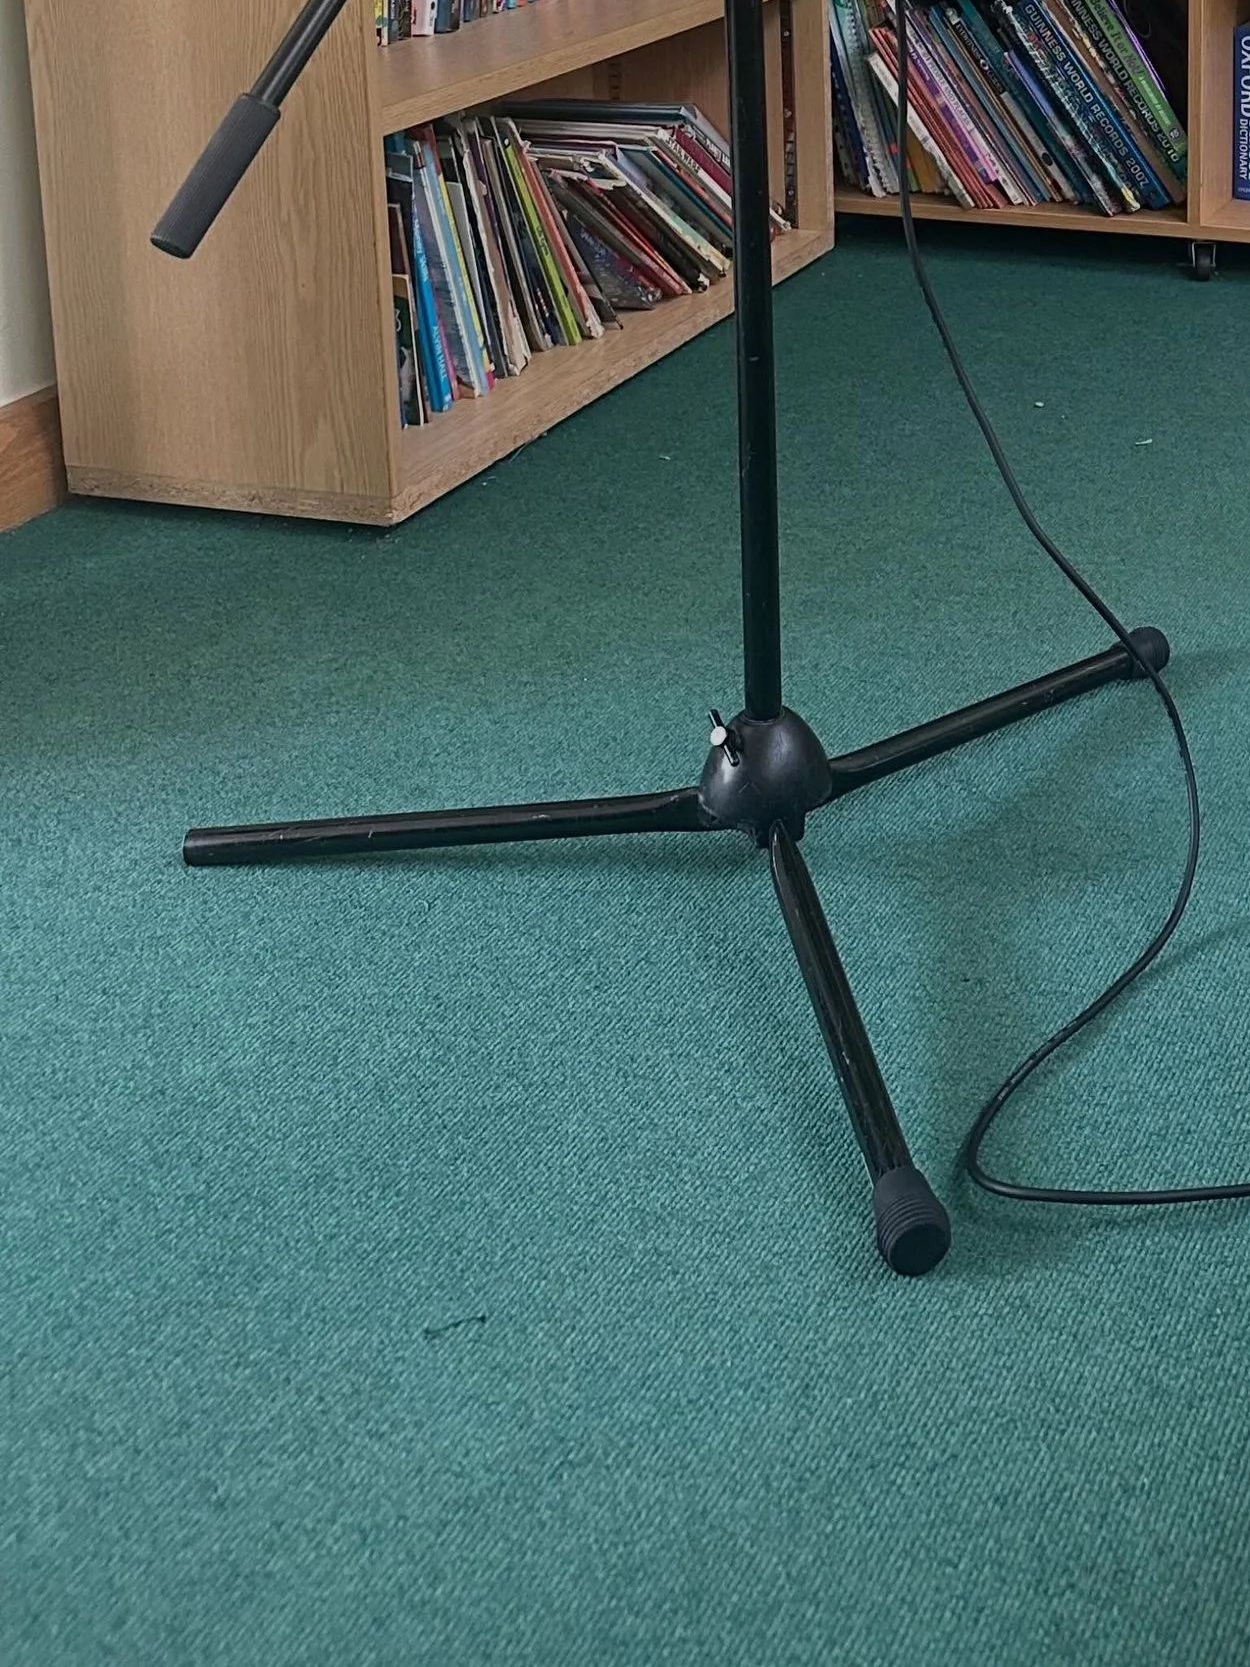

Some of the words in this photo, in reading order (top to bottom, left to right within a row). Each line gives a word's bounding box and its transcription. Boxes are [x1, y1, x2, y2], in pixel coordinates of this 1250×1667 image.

[1024, 3, 1066, 62] GUINNESS
[1063, 59, 1094, 103] WORLD
[1090, 102, 1129, 157] RECORDS
[1124, 155, 1150, 190] 2007
[1098, 38, 1128, 82] WORLD
[1123, 79, 1160, 133] RECORDS
[1155, 131, 1180, 163] 2010
[1239, 118, 1249, 181] DICTIONARY
